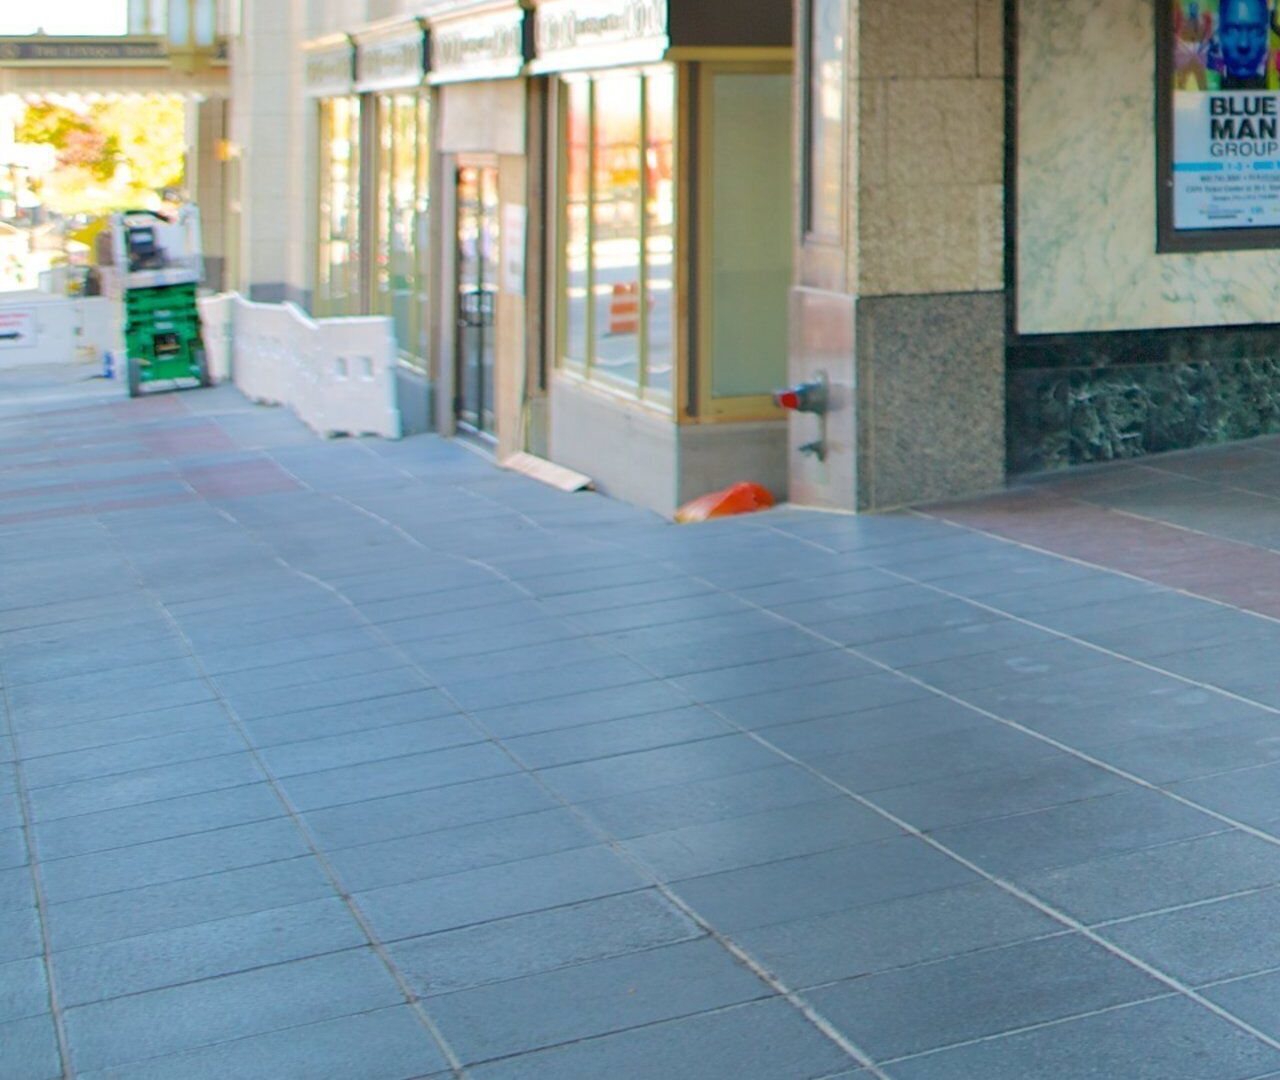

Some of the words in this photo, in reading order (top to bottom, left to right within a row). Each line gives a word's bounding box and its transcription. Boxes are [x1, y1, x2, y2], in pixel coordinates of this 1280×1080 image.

[1210, 96, 1277, 116] BLUE
[1210, 118, 1277, 139] MAN
[1210, 142, 1279, 157] GROUP
